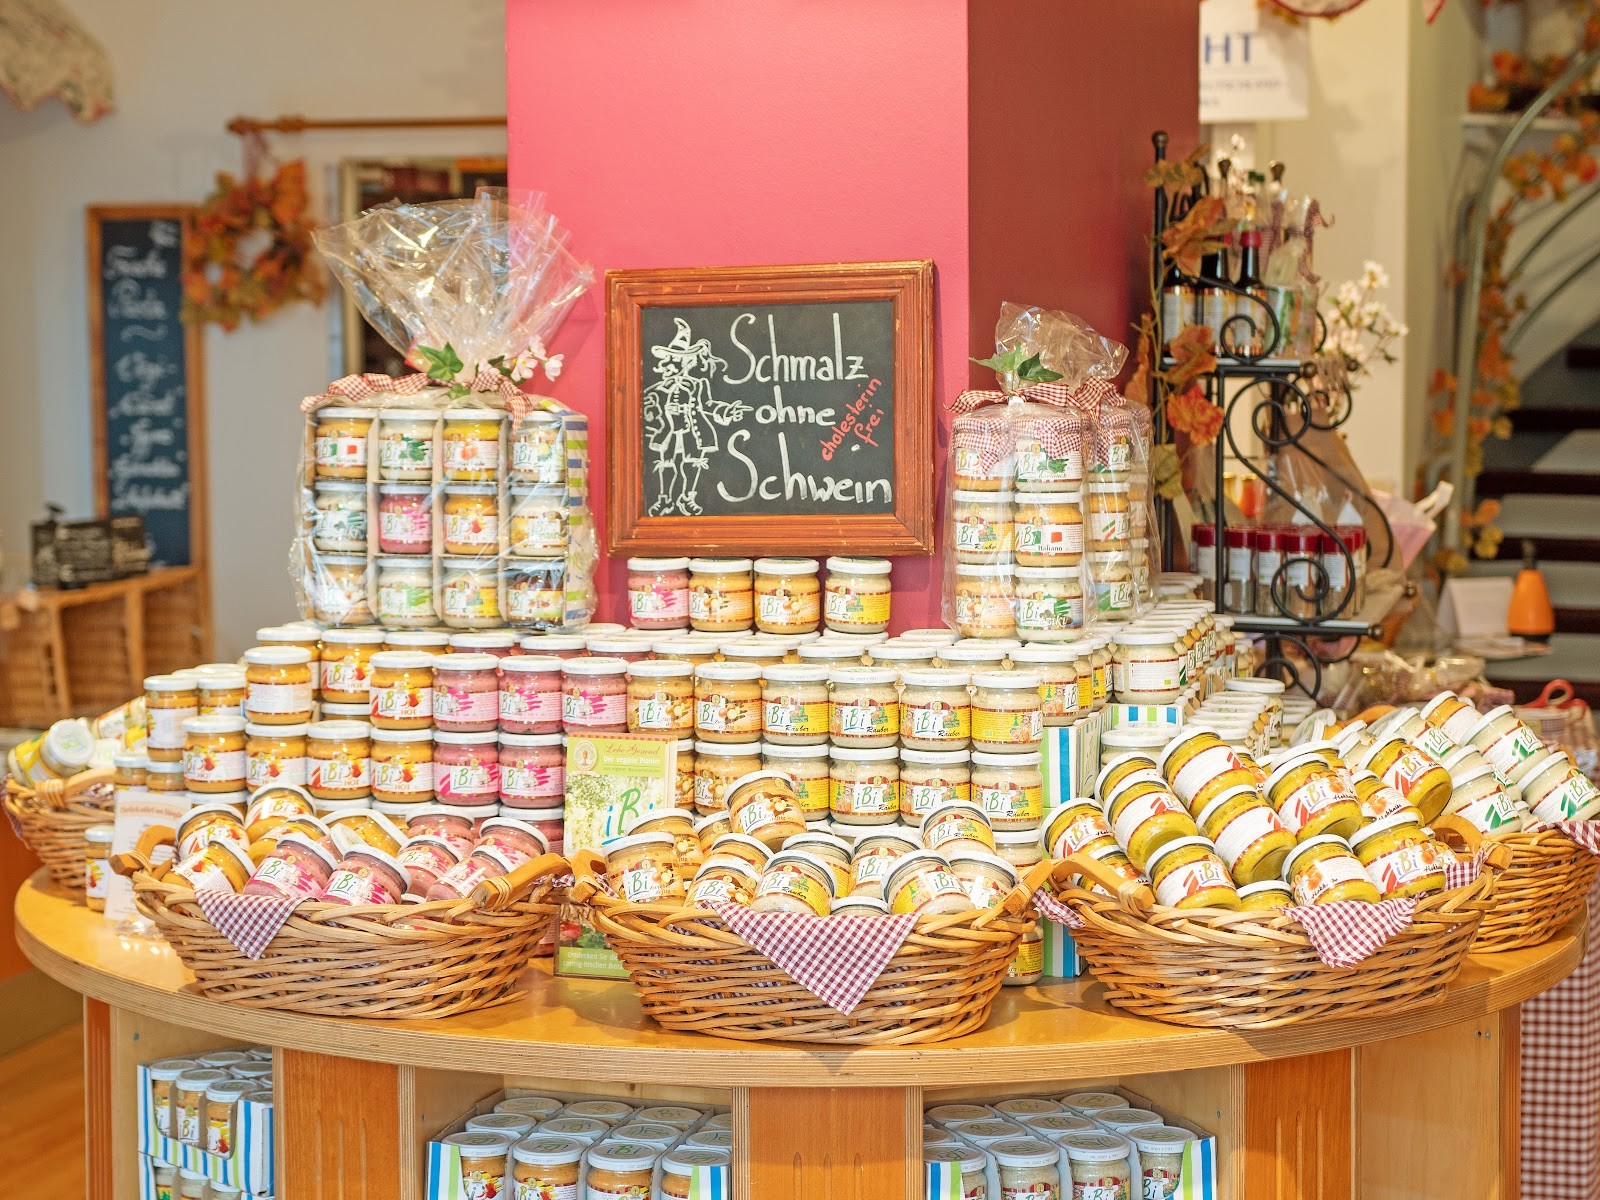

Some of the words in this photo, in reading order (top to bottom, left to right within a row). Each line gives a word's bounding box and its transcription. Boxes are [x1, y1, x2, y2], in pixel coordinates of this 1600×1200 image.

[723, 312, 868, 385] Schmalz
[755, 385, 836, 426] ohne
[821, 377, 882, 462] cholesterin
[854, 403, 885, 447] frei
[717, 429, 893, 503] Schwein
[1038, 544, 1063, 552] Italiano
[381, 690, 400, 710] iBi
[401, 708, 417, 716] HOT
[642, 702, 663, 721] iBi
[845, 708, 865, 729] iBi
[916, 709, 937, 732] iBi
[626, 744, 661, 756] Gesund
[324, 763, 344, 782] iBi
[856, 786, 876, 808] iBi
[915, 788, 935, 809] iBi
[985, 790, 1005, 811] iBi
[743, 805, 762, 828] iBi
[1006, 809, 1030, 818] Räuber
[861, 856, 881, 877] iBi
[1199, 862, 1220, 882] iBi
[628, 871, 649, 895] iBi
